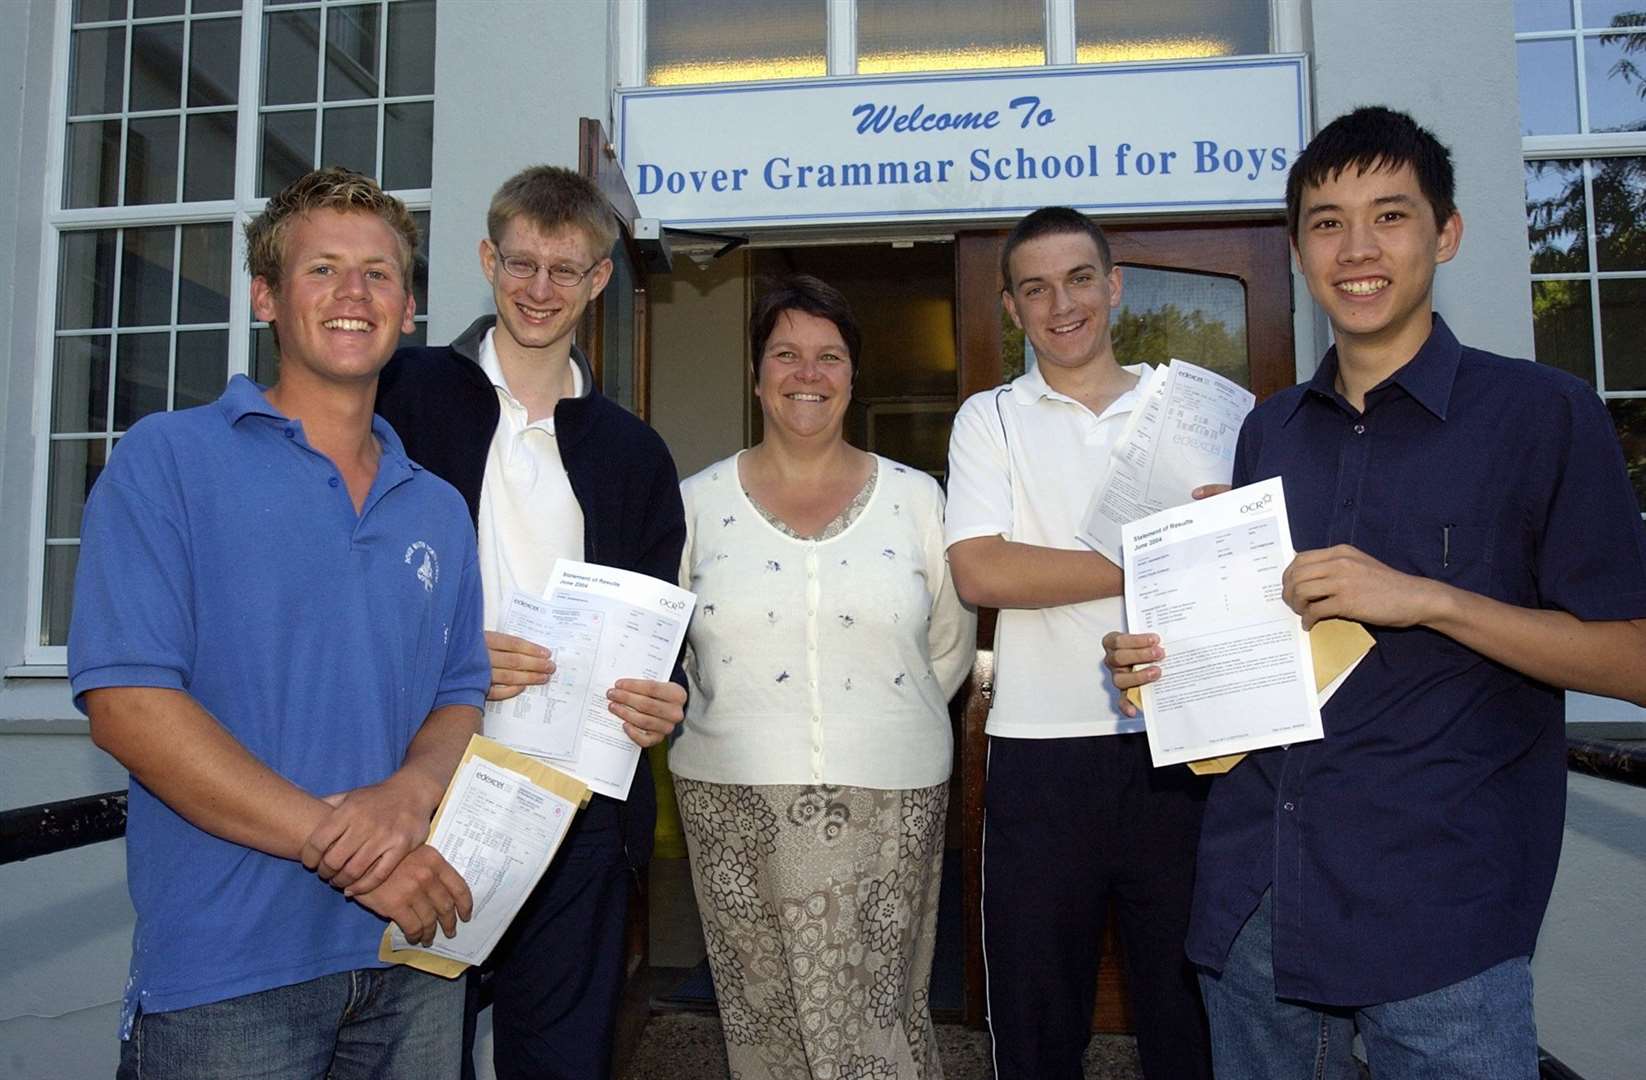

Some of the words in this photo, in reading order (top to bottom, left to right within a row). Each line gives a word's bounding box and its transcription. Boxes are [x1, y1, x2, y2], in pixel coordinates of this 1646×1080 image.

[852, 103, 1000, 135] Welcome
[1008, 95, 1056, 130] To
[637, 161, 749, 195] Dover
[763, 155, 954, 191] Grammar
[969, 144, 1100, 182] School
[1115, 142, 1178, 177] for
[1193, 139, 1288, 181] Boys
[1240, 500, 1264, 514] OCR
[1133, 527, 1162, 542] Statement
[1162, 525, 1169, 533] of
[1170, 518, 1194, 530] Results
[1134, 540, 1148, 551] June
[562, 571, 591, 582] Statement
[599, 578, 621, 587] Results
[476, 771, 505, 789] edexcel
